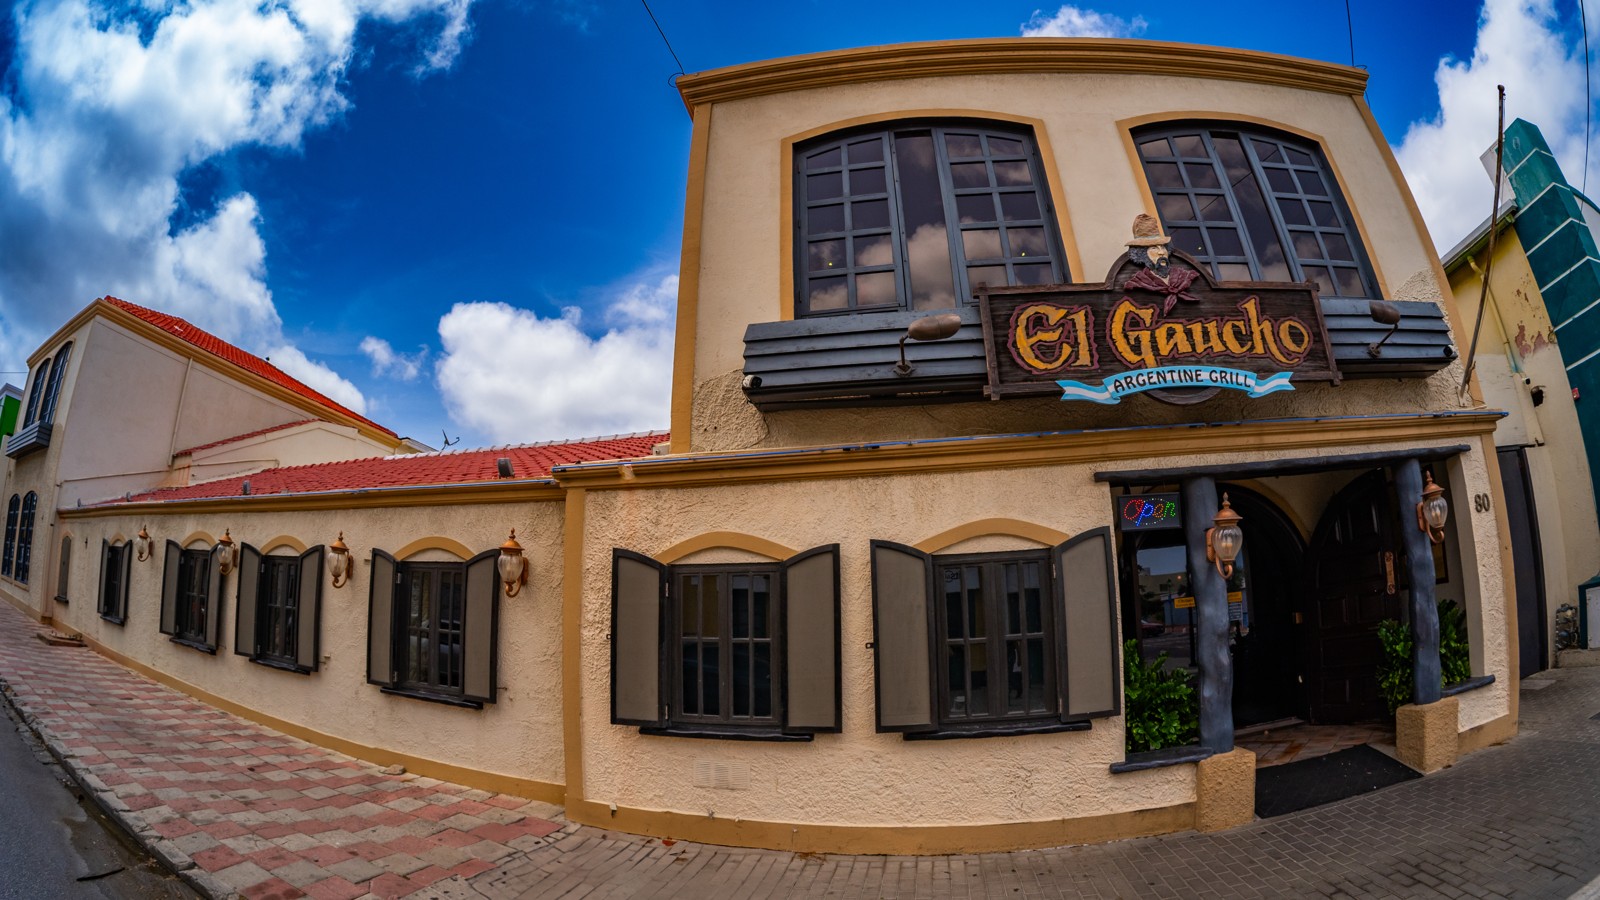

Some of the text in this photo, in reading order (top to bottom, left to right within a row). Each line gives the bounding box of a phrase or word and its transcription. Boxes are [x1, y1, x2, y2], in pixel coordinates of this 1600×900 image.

[1011, 297, 1310, 371] El Gaucho
[1113, 369, 1251, 393] ARGENTINE GRILL
[1123, 499, 1176, 527] Open
[1474, 492, 1490, 513] 80
